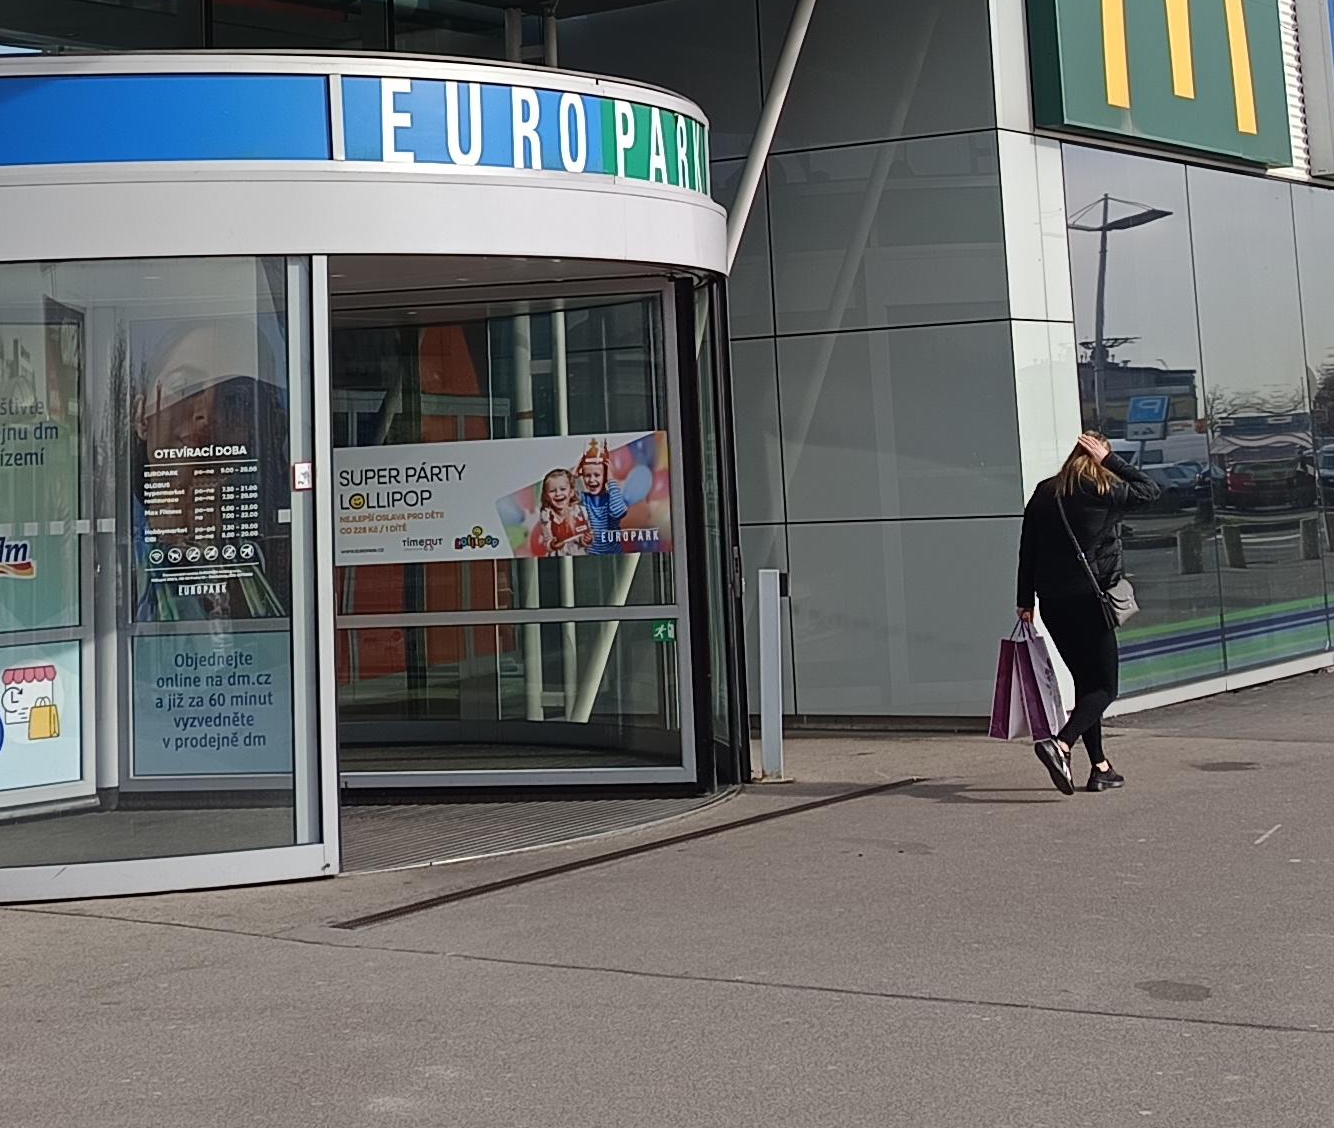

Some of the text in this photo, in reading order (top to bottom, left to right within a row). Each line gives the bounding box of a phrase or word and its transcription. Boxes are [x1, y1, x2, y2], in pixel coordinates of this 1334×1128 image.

[33, 423, 59, 440] dm
[154, 445, 248, 459] OTEVÍRACÍ DOBA
[339, 461, 466, 487] SUPER PÁRTY
[339, 489, 433, 511] LOLLIPOP
[339, 513, 376, 524] NEJLEPŠÍ
[375, 513, 406, 523] OSLAVA
[406, 512, 424, 520] PRO
[600, 528, 660, 543] EUROPARK
[178, 583, 228, 596] EUROPARK
[174, 651, 253, 670] Objednejte
[156, 672, 272, 689] online na dm.cz
[155, 691, 274, 712] a již za 60 minut
[173, 712, 255, 732] vyzvedněte
[162, 731, 267, 751] v prodejně dm
